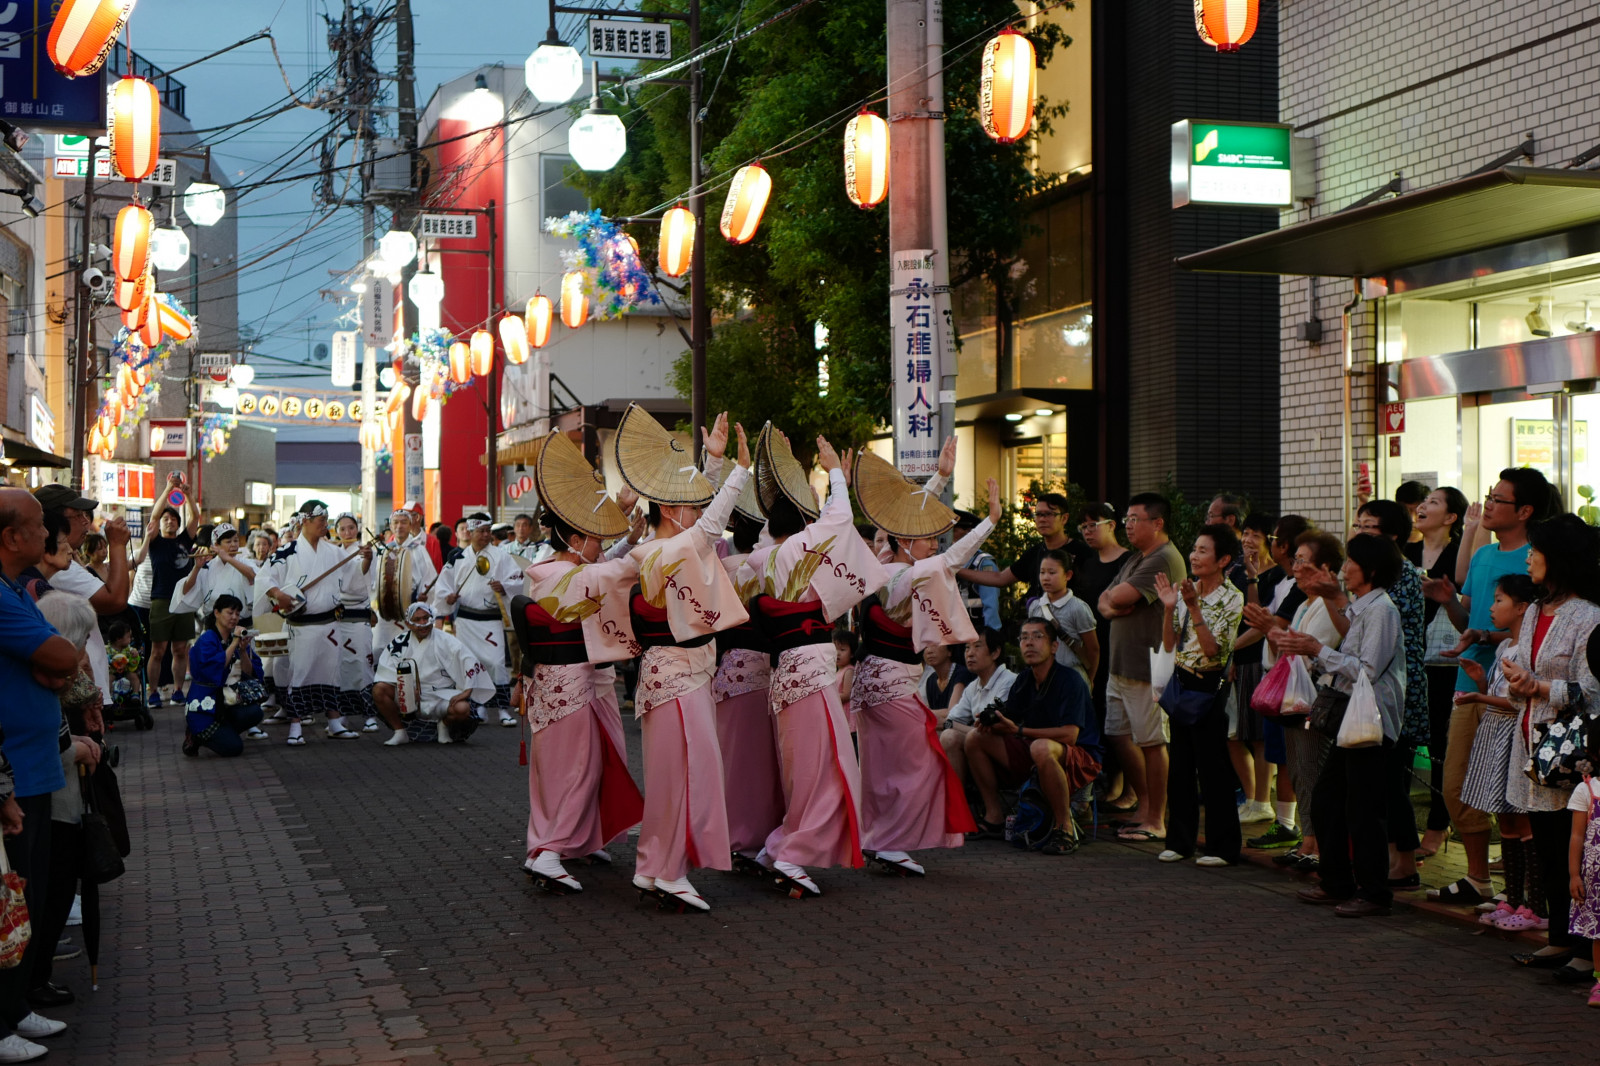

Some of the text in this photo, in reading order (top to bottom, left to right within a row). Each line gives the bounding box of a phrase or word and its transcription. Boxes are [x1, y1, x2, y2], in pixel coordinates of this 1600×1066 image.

[5, 101, 64, 116] 御嶽山店
[1217, 153, 1244, 164] SMBC
[906, 277, 934, 437] 永石産婦人科
[1387, 403, 1404, 413] AED
